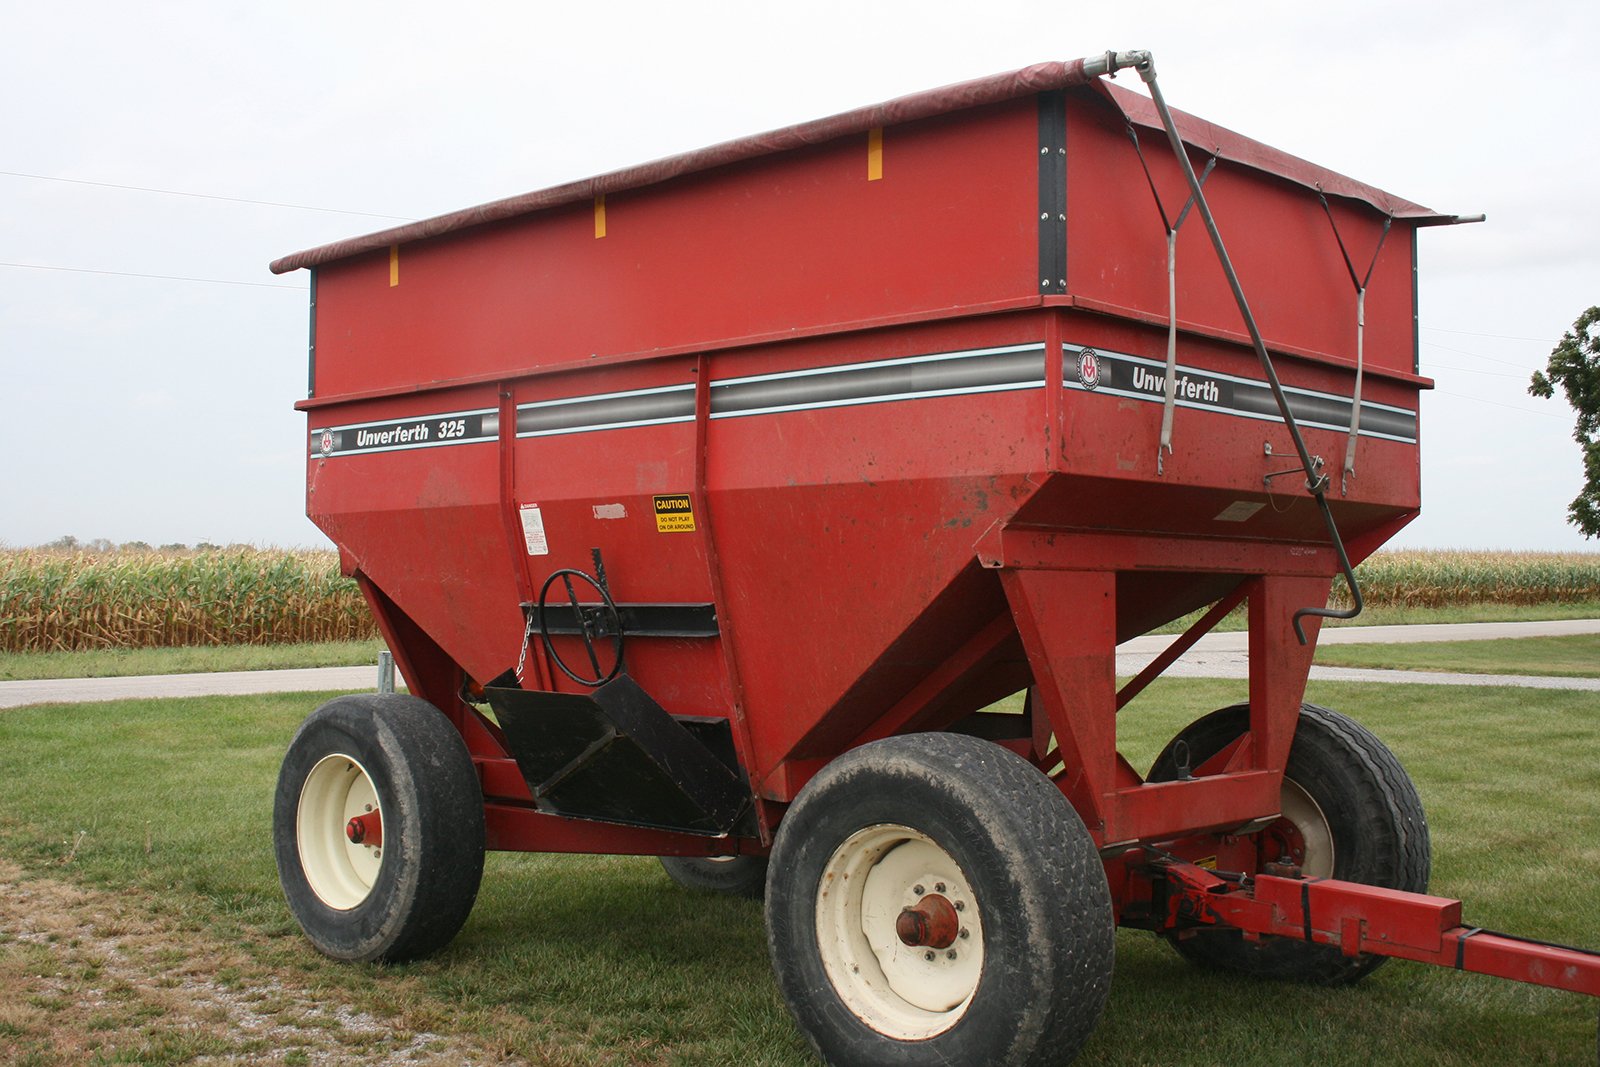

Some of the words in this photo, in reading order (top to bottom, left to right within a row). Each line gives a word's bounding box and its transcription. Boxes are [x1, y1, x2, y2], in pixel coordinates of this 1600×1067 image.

[357, 424, 429, 446] Unverferth
[438, 419, 466, 439] 325
[656, 499, 689, 510] CAUTION
